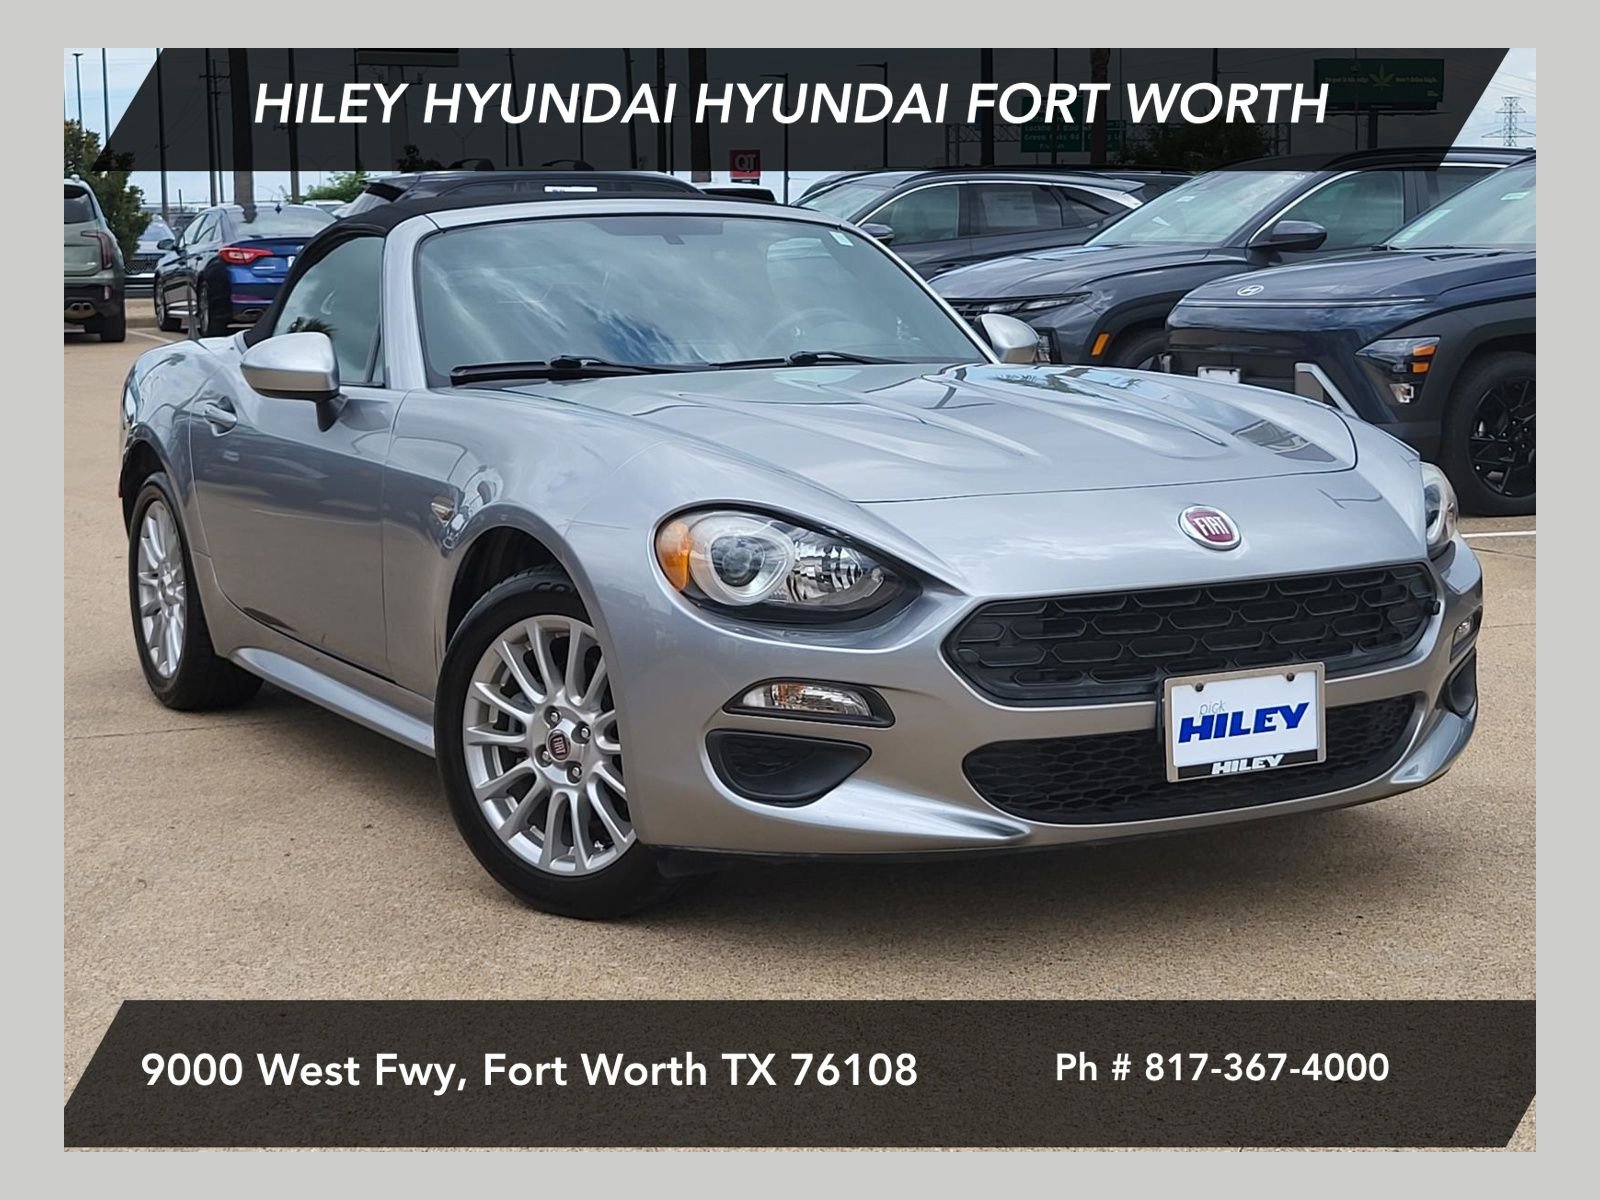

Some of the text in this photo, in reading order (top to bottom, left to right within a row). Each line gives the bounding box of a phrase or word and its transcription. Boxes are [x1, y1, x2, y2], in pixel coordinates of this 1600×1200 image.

[735, 154, 756, 171] QT
[1193, 516, 1230, 536] FIAT
[1199, 700, 1226, 716] pick
[1178, 702, 1310, 744] HILEY
[1211, 753, 1285, 775] HILEY
